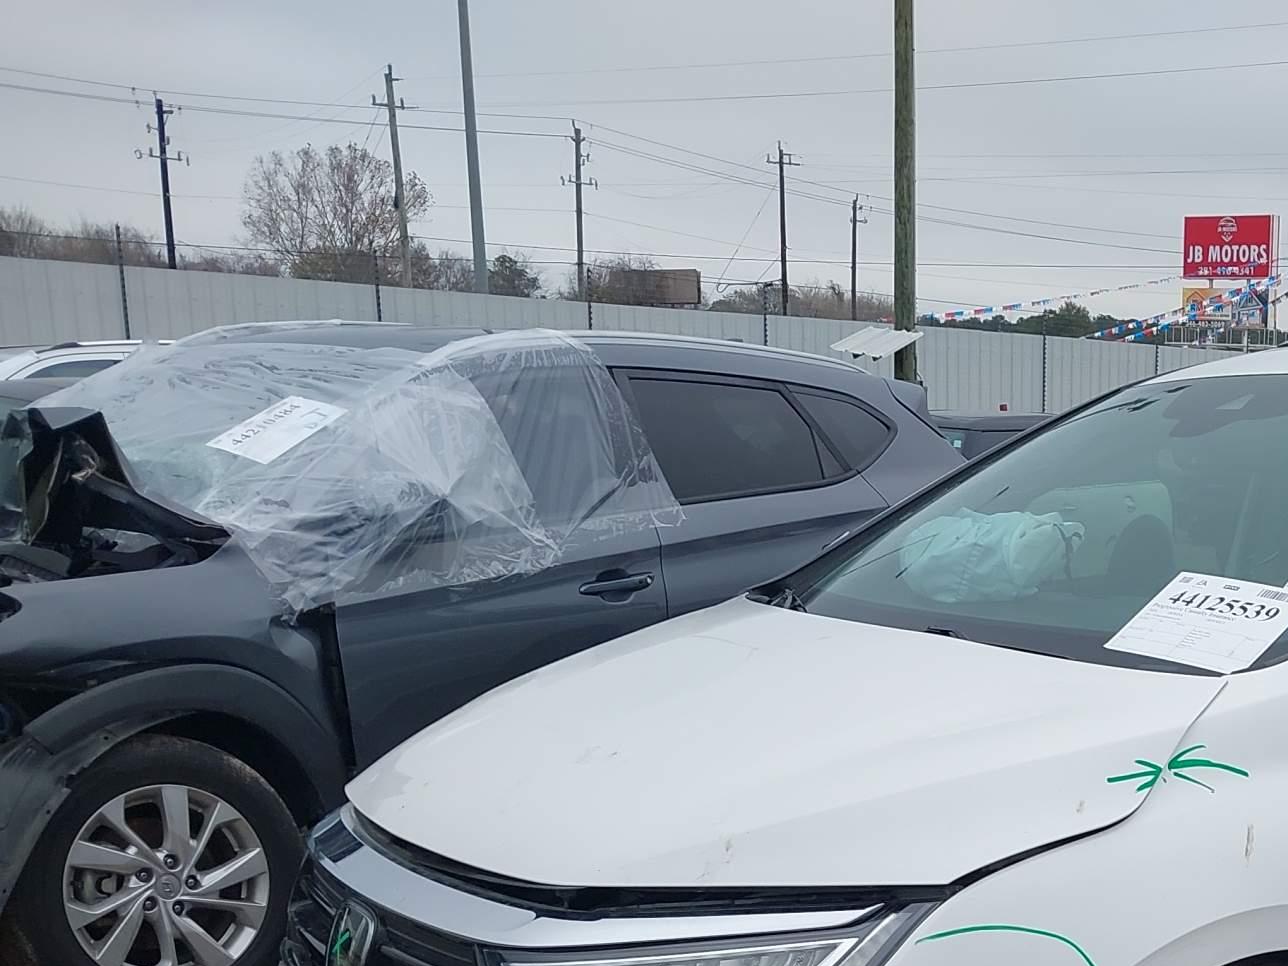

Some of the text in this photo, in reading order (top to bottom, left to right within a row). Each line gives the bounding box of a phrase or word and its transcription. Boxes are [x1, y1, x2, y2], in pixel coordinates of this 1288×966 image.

[1187, 244, 1268, 264] JB MOTORS
[231, 403, 301, 446] 44210484
[1168, 590, 1281, 621] 44125539
